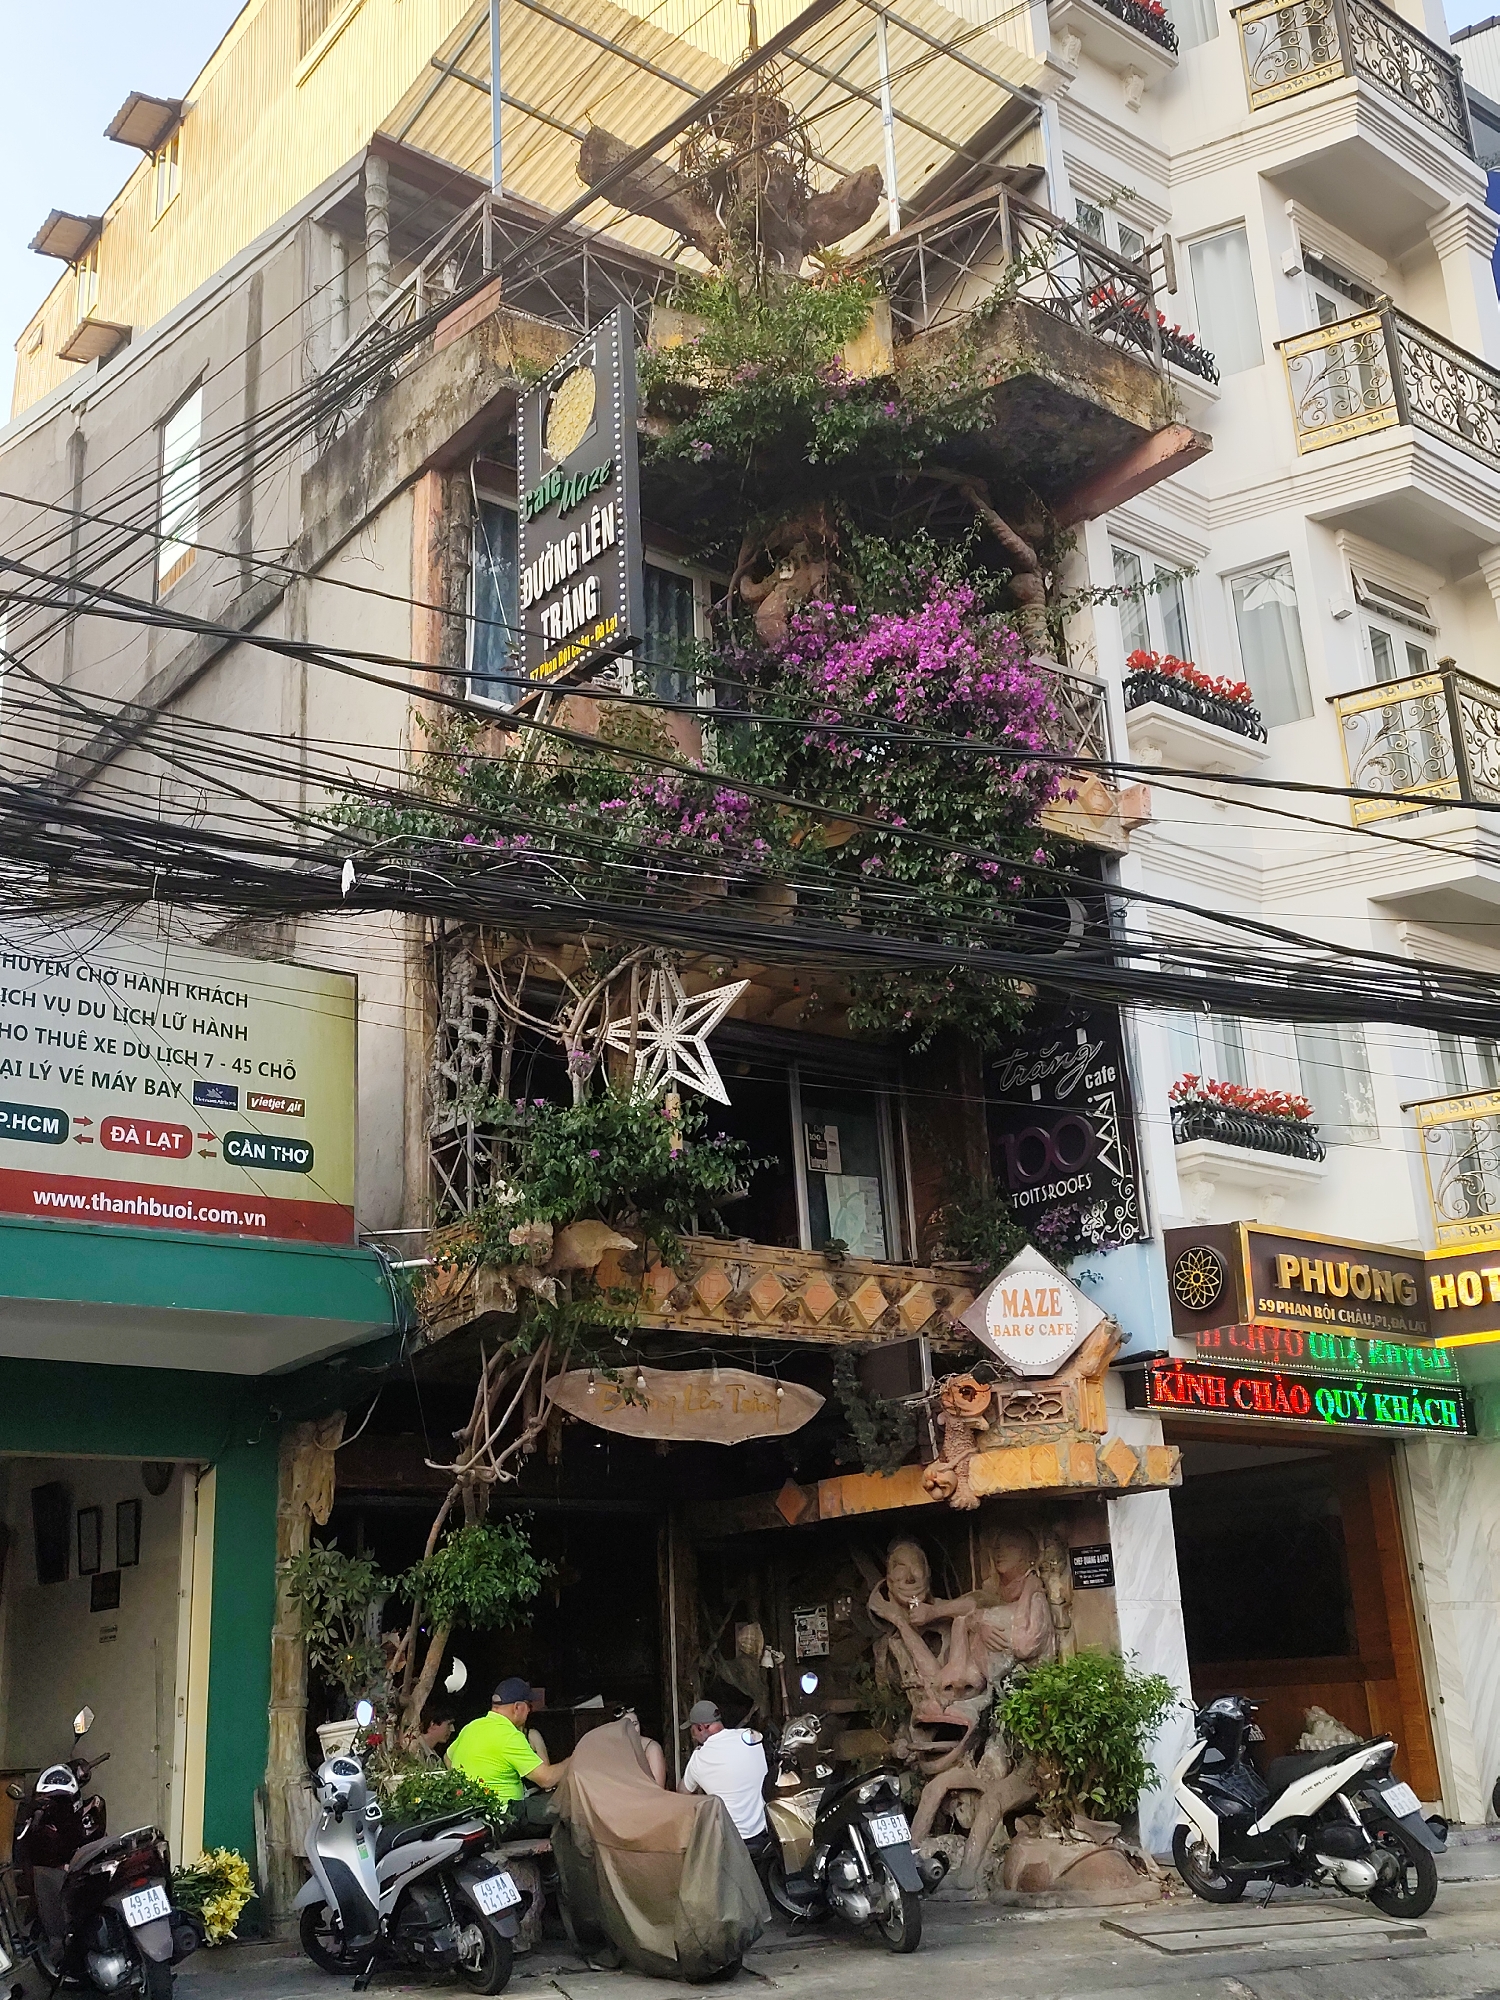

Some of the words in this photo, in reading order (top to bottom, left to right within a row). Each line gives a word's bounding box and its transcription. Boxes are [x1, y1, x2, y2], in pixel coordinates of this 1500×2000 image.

[523, 531, 578, 610] ĐƯỜNG
[580, 501, 616, 565] LÊN
[541, 575, 600, 651] TRĂNG
[124, 969, 180, 998] HÀNH
[185, 983, 249, 1009] KHÁCH
[43, 992, 71, 1017] VỤ
[77, 999, 106, 1019] DU
[113, 1004, 156, 1026] LỊCH
[162, 1011, 188, 1031] LỮ
[193, 1016, 249, 1042] HÀNH
[34, 1028, 88, 1051] THUÊ
[93, 1035, 117, 1055] XE
[123, 1041, 151, 1061] DU
[156, 1046, 199, 1067] LỊCH
[203, 1052, 214, 1069] 7
[231, 1057, 253, 1075] 45
[257, 1058, 297, 1081] CHỖ
[29, 1060, 52, 1081] LÝ
[58, 1064, 85, 1087] VÉ
[91, 1070, 138, 1094] MÁY
[144, 1078, 183, 1099] BAY
[1084, 1064, 1117, 1090] cafe
[110, 1124, 140, 1146] ĐÀ
[145, 1130, 184, 1151] LẠT
[227, 1138, 267, 1161] CẦN
[270, 1146, 309, 1164] THƠ
[33, 1190, 267, 1228] www.thanhbuoi.com.vn
[1275, 1253, 1417, 1308] PHƯƠNG
[1001, 1288, 1062, 1318] MAZE
[1258, 1298, 1275, 1313] 59
[1276, 1300, 1312, 1318] PHAN
[1314, 1303, 1336, 1324] BỘI
[993, 1324, 1021, 1337] BAR
[1024, 1324, 1035, 1336] &
[1038, 1323, 1074, 1337] CAFE
[1153, 1366, 1229, 1407] KÍNH
[1233, 1374, 1311, 1415] CHÀO
[1314, 1382, 1367, 1424] QUÝ
[1374, 1389, 1460, 1428] KHÁCH
[876, 1817, 901, 1831] 49-B1
[129, 1888, 160, 1910] 49-AA
[480, 1876, 507, 1898] 49-AA
[483, 1889, 517, 1911] 141.39
[129, 1900, 168, 1924] 113.64
